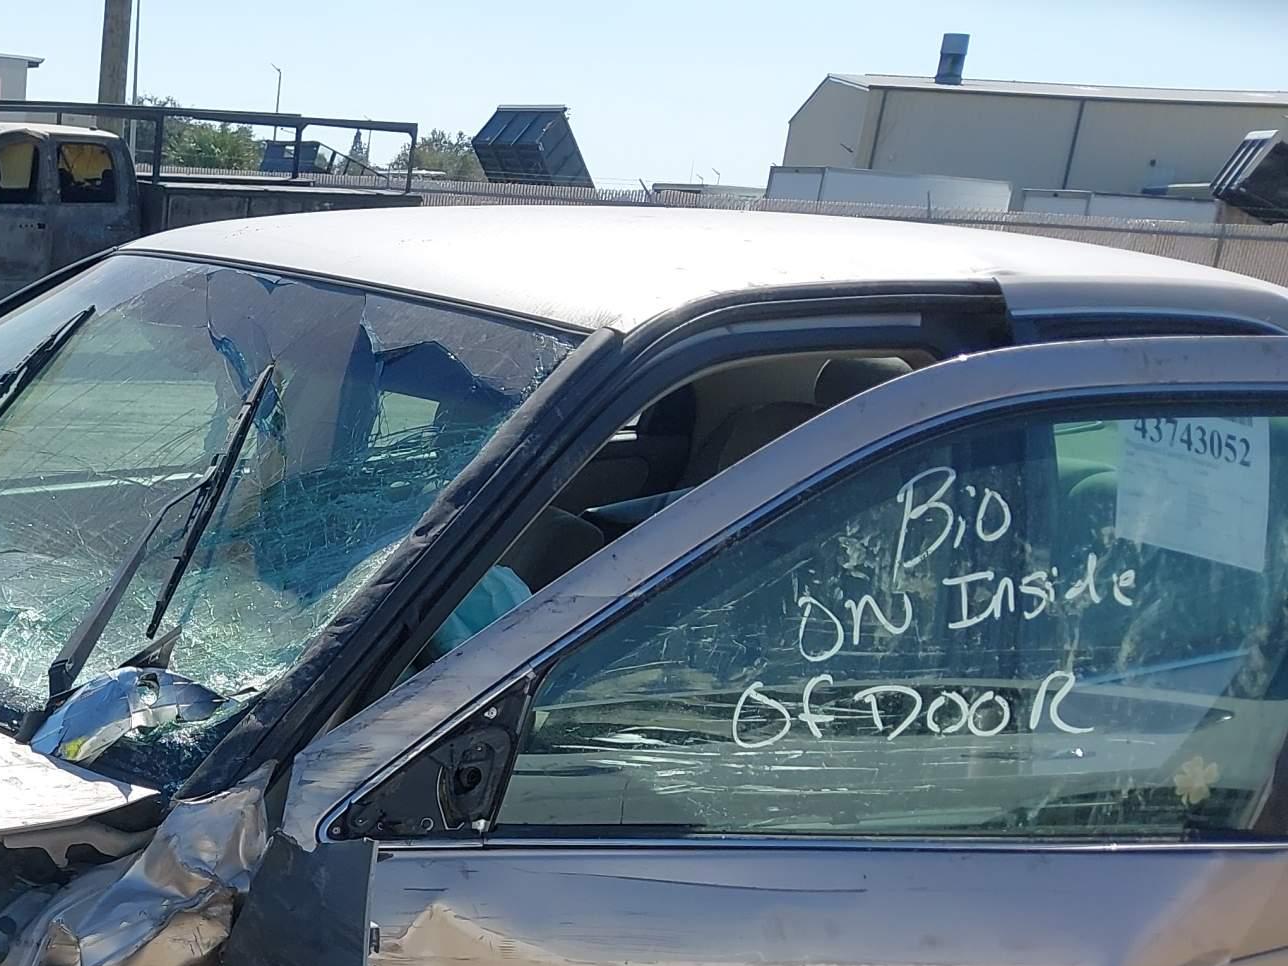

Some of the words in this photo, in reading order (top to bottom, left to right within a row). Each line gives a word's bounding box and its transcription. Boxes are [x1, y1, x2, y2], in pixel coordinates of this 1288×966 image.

[1133, 416, 1252, 468] 43743052
[942, 552, 1136, 630] Inside
[853, 670, 1095, 741] DOOR
